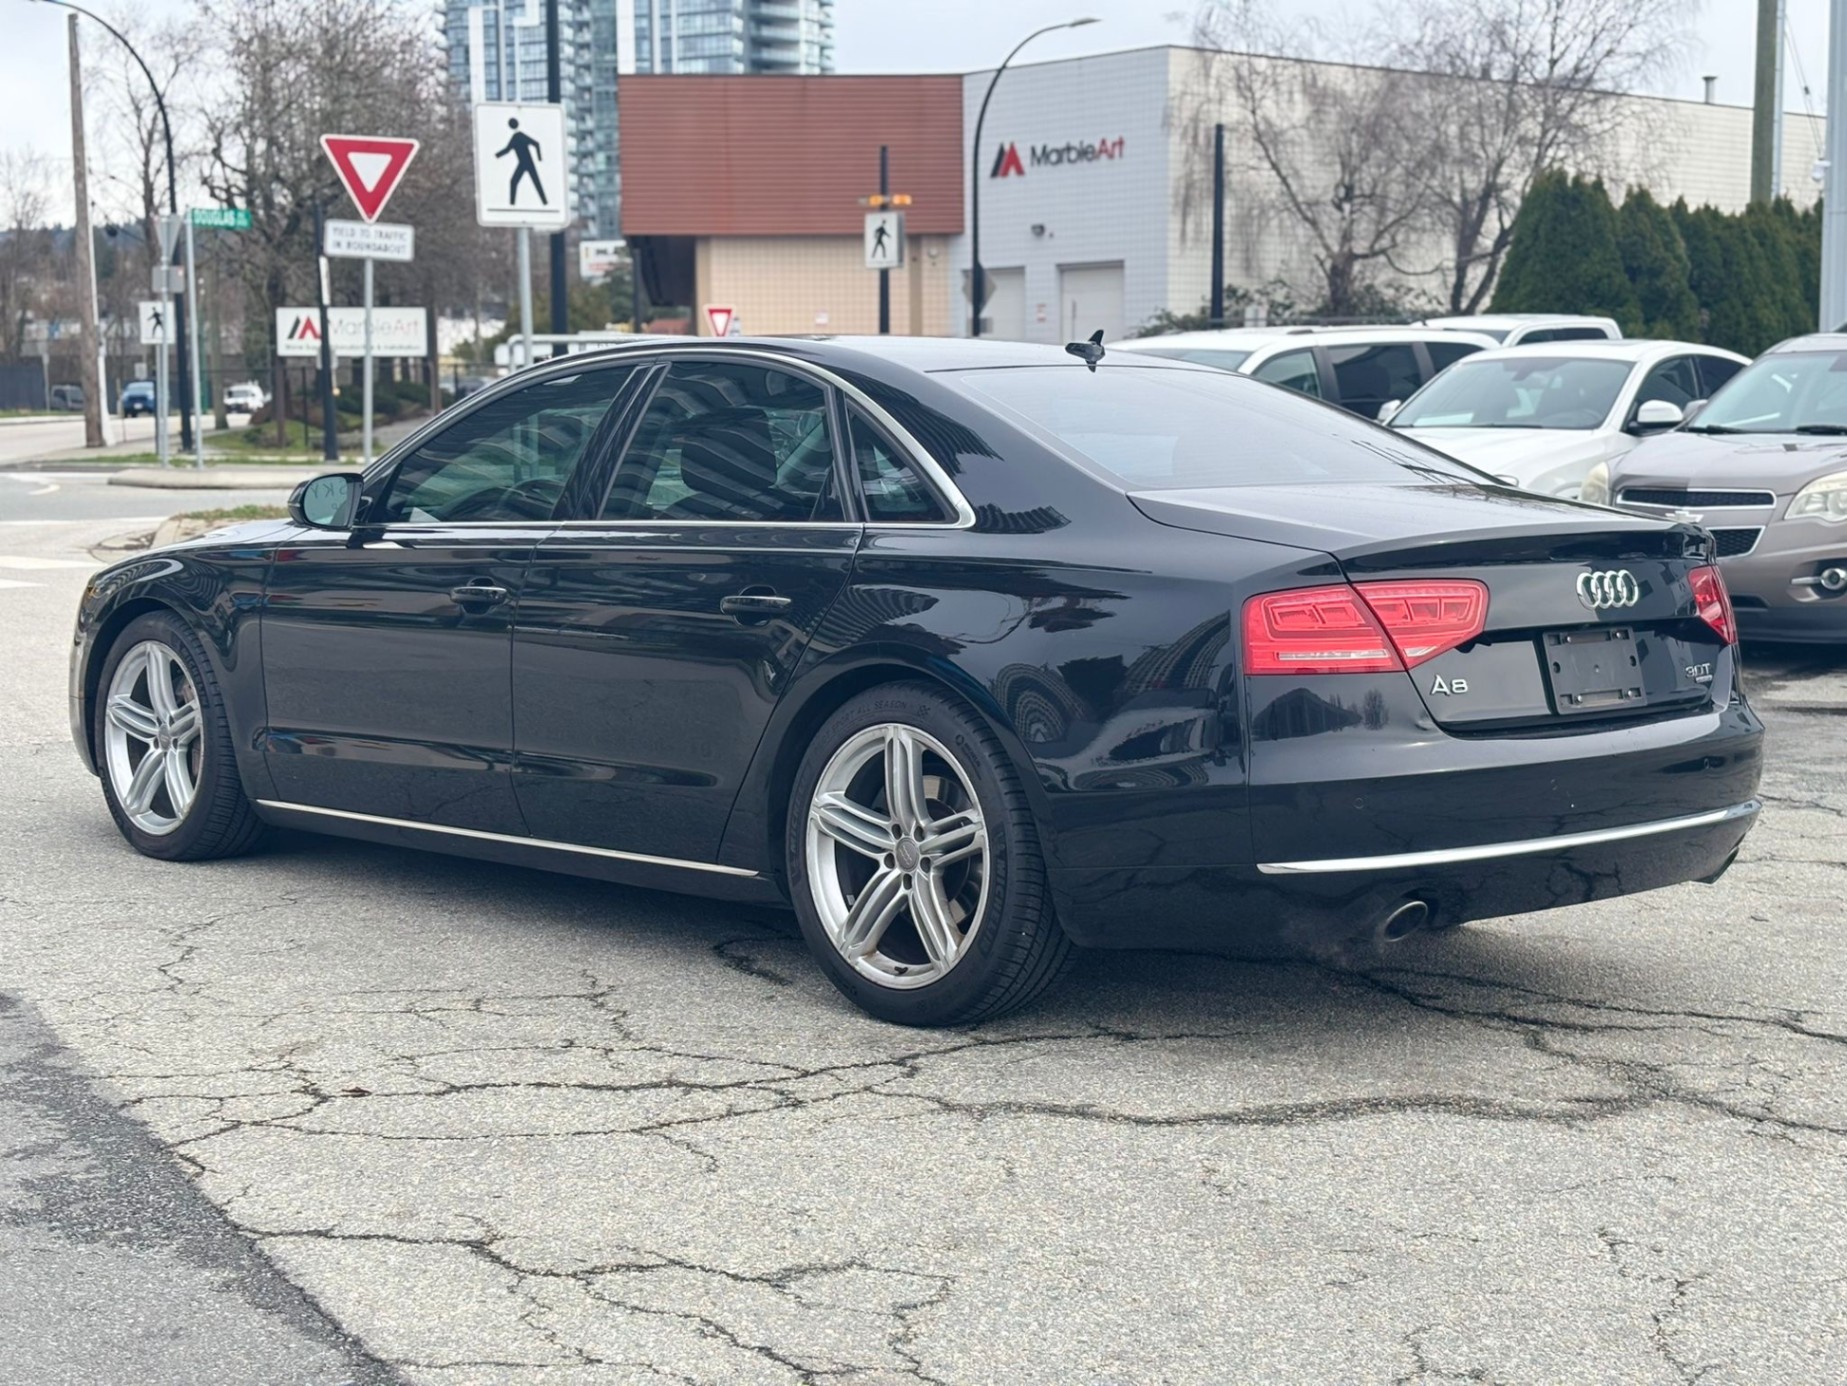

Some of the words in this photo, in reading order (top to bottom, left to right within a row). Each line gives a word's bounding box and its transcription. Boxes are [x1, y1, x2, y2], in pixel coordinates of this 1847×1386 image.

[1030, 136, 1125, 166] MarbleArt
[194, 209, 235, 226] DOUGLAS
[333, 227, 356, 238] YIELD
[360, 228, 370, 239] TO
[374, 230, 408, 241] TRAFFIC
[332, 241, 342, 249] IN
[346, 241, 407, 254] ROUNDABOUT
[1431, 674, 1468, 696] A8
